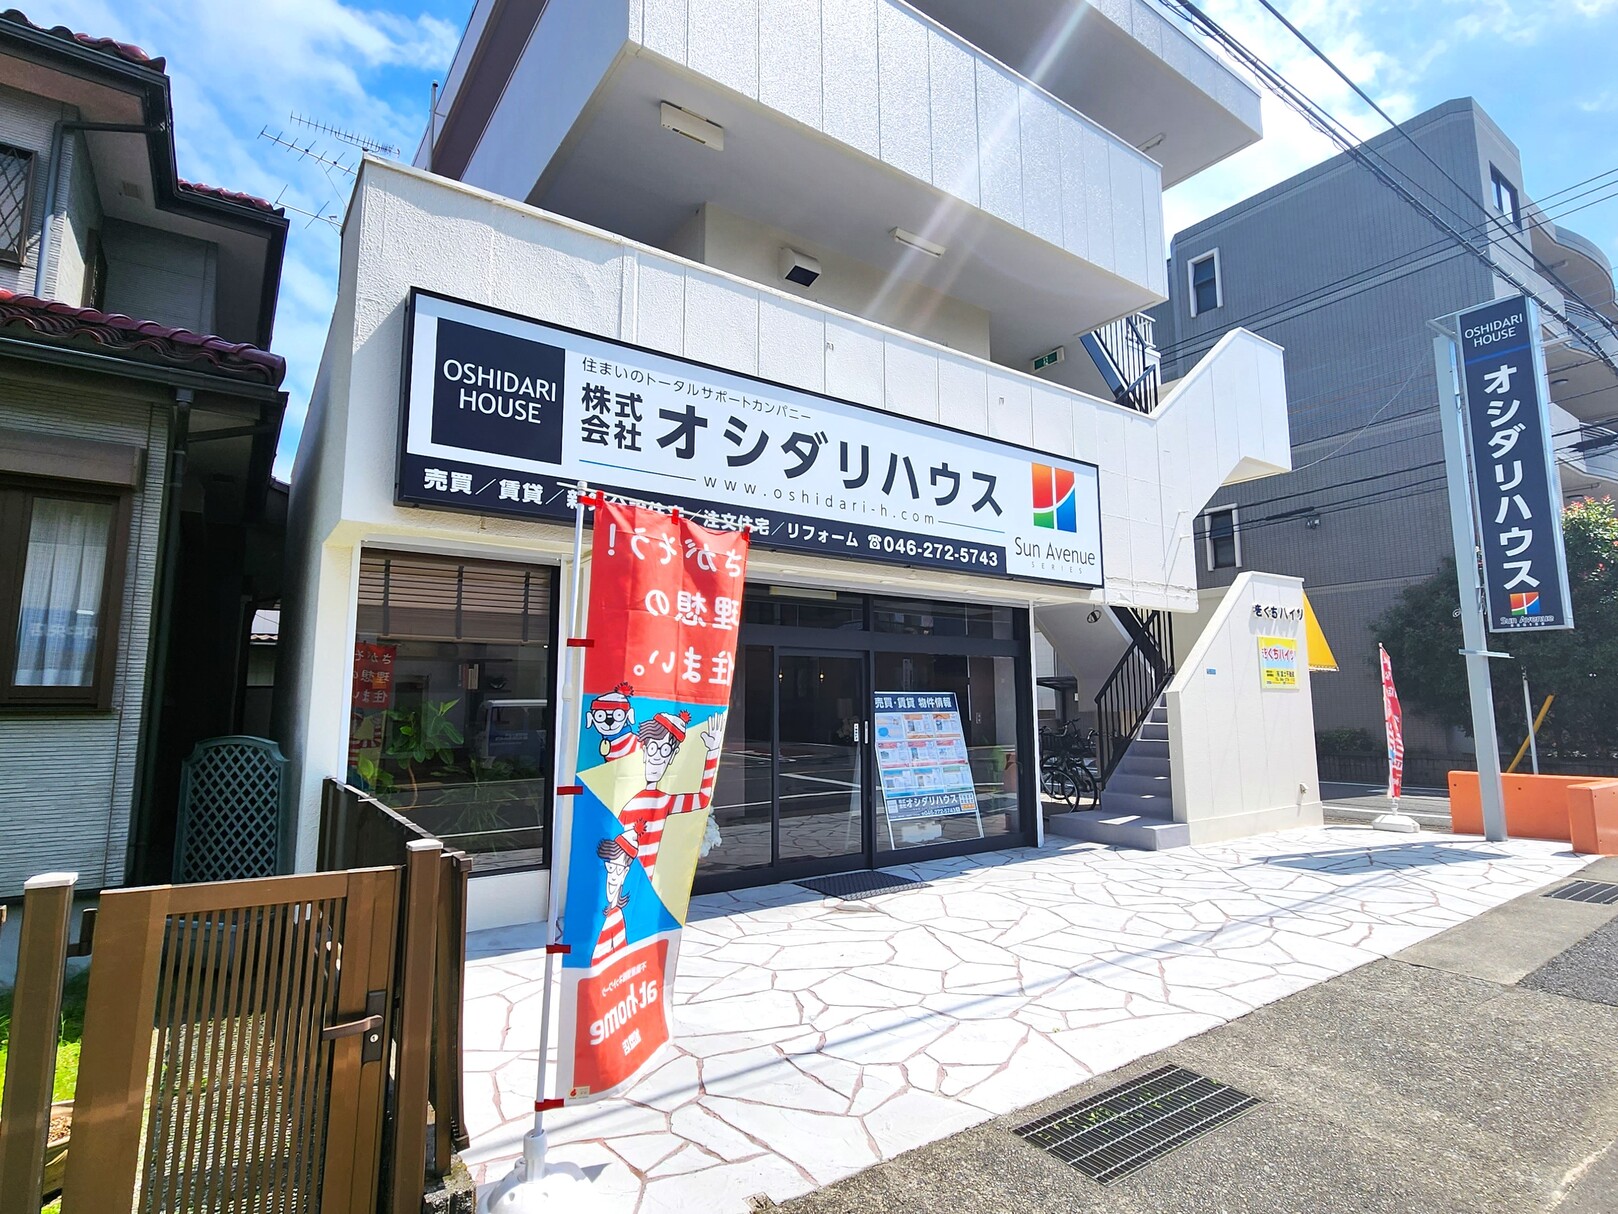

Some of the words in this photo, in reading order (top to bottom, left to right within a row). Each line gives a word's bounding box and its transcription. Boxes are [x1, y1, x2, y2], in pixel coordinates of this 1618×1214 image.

[1464, 313, 1523, 339] OSHIDARI
[1473, 326, 1517, 348] HOUSE
[442, 358, 557, 402] OSHIDARI
[582, 356, 812, 421] 住まいのトータルサポートカンパニー
[458, 387, 542, 424] HOUSE
[580, 382, 644, 424] 株式
[580, 414, 643, 452] 会社
[655, 404, 1004, 518] オシダリハウス
[1483, 363, 1541, 591] オシダリハウス
[703, 475, 935, 525] www.oshidari-h.com
[883, 536, 998, 567] 046-272-5743
[1014, 536, 1041, 560] Sun
[1045, 541, 1096, 567] Avenue
[1030, 562, 1084, 574] SERIES
